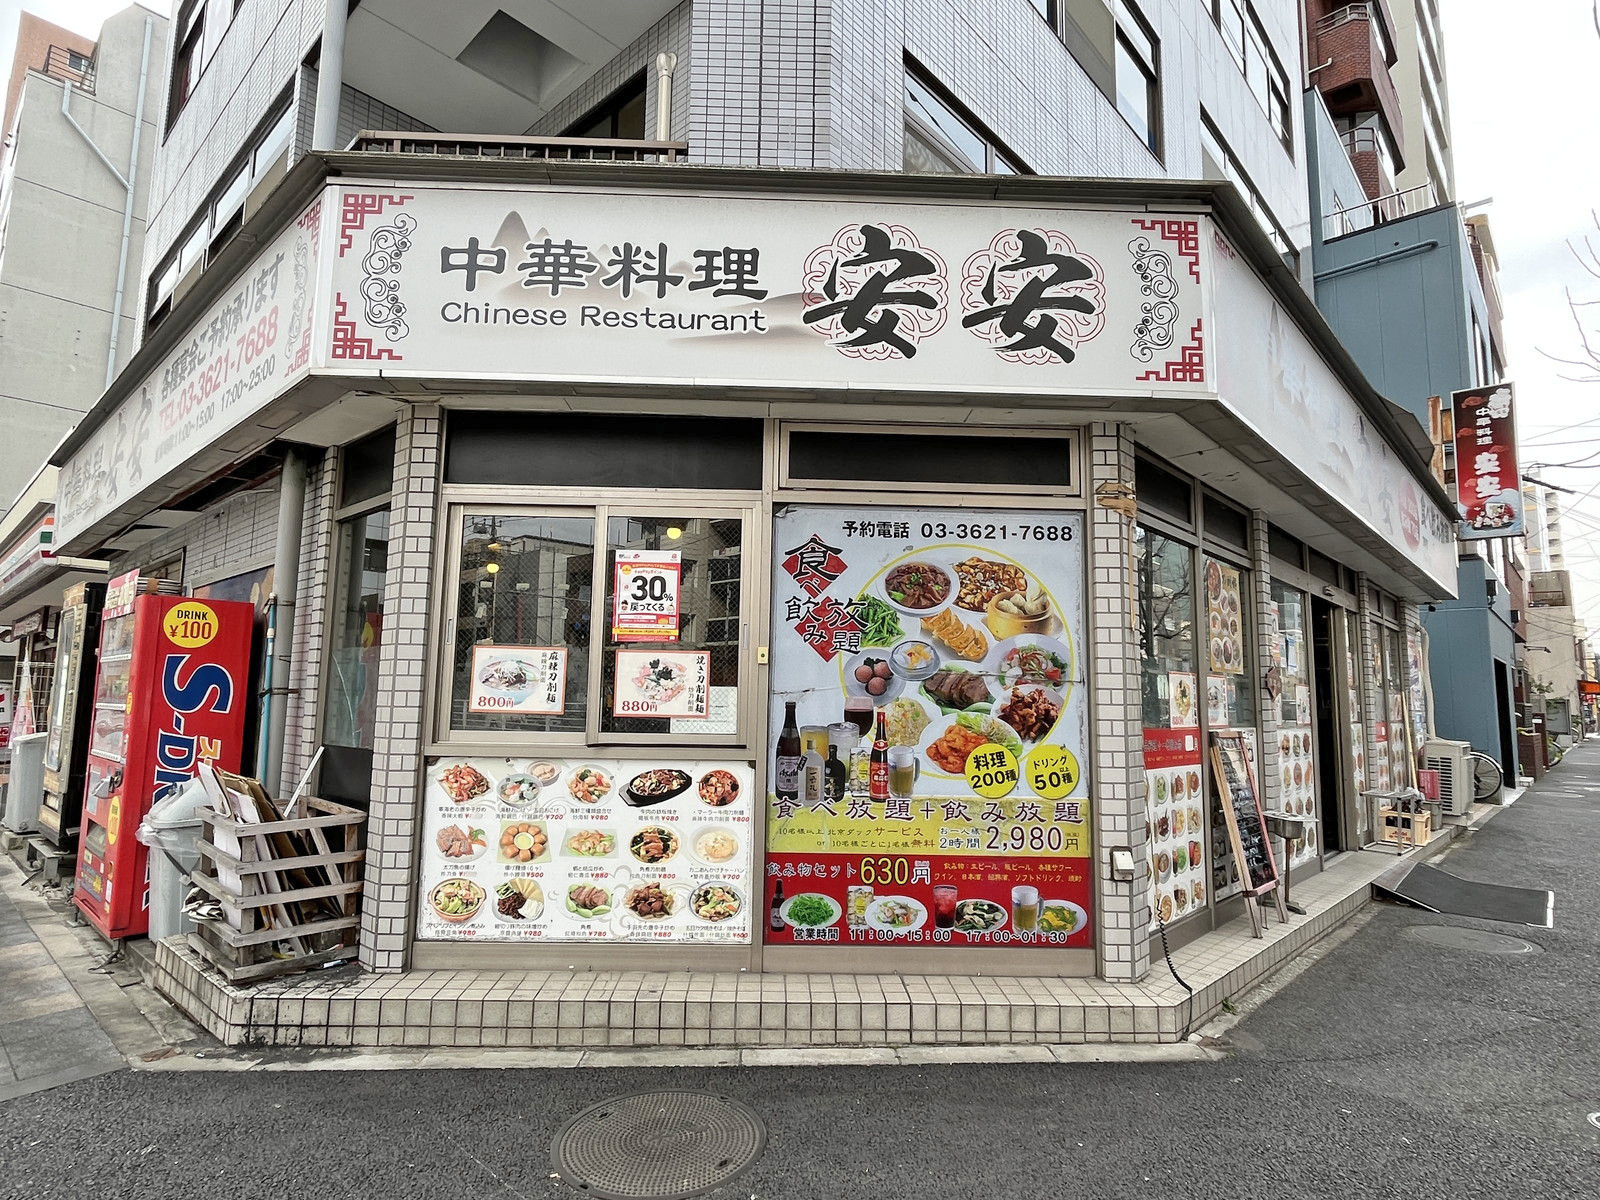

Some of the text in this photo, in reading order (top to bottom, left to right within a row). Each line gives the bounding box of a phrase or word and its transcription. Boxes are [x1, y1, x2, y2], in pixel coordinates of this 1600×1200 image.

[440, 224, 1105, 363] 中華料理 安安
[440, 302, 767, 332] Chinese Restaurant
[161, 253, 284, 402] 各種宴会ご予約承ります
[160, 305, 279, 432] TEL:03-3621-7688
[842, 520, 1073, 541] 予約電話 03-3621-7688
[785, 537, 843, 594] 食べ
[631, 575, 674, 602] 30%
[177, 609, 208, 621] DRINK
[630, 602, 665, 612] 戻ってくる
[169, 621, 213, 639] ¥100
[824, 597, 868, 655] 放題
[478, 696, 514, 708] 800円
[622, 701, 658, 712] 880円
[973, 751, 1007, 771] 料理
[1033, 755, 1068, 770] ドリンク
[971, 770, 1018, 789] 200種
[1035, 771, 1073, 790] 50種
[940, 827, 980, 835] お一人様
[986, 826, 1079, 851] 2,980円
[940, 837, 980, 849] 2時間
[767, 857, 931, 885] 飲み物セット 630円
[794, 928, 839, 940] 営業時間
